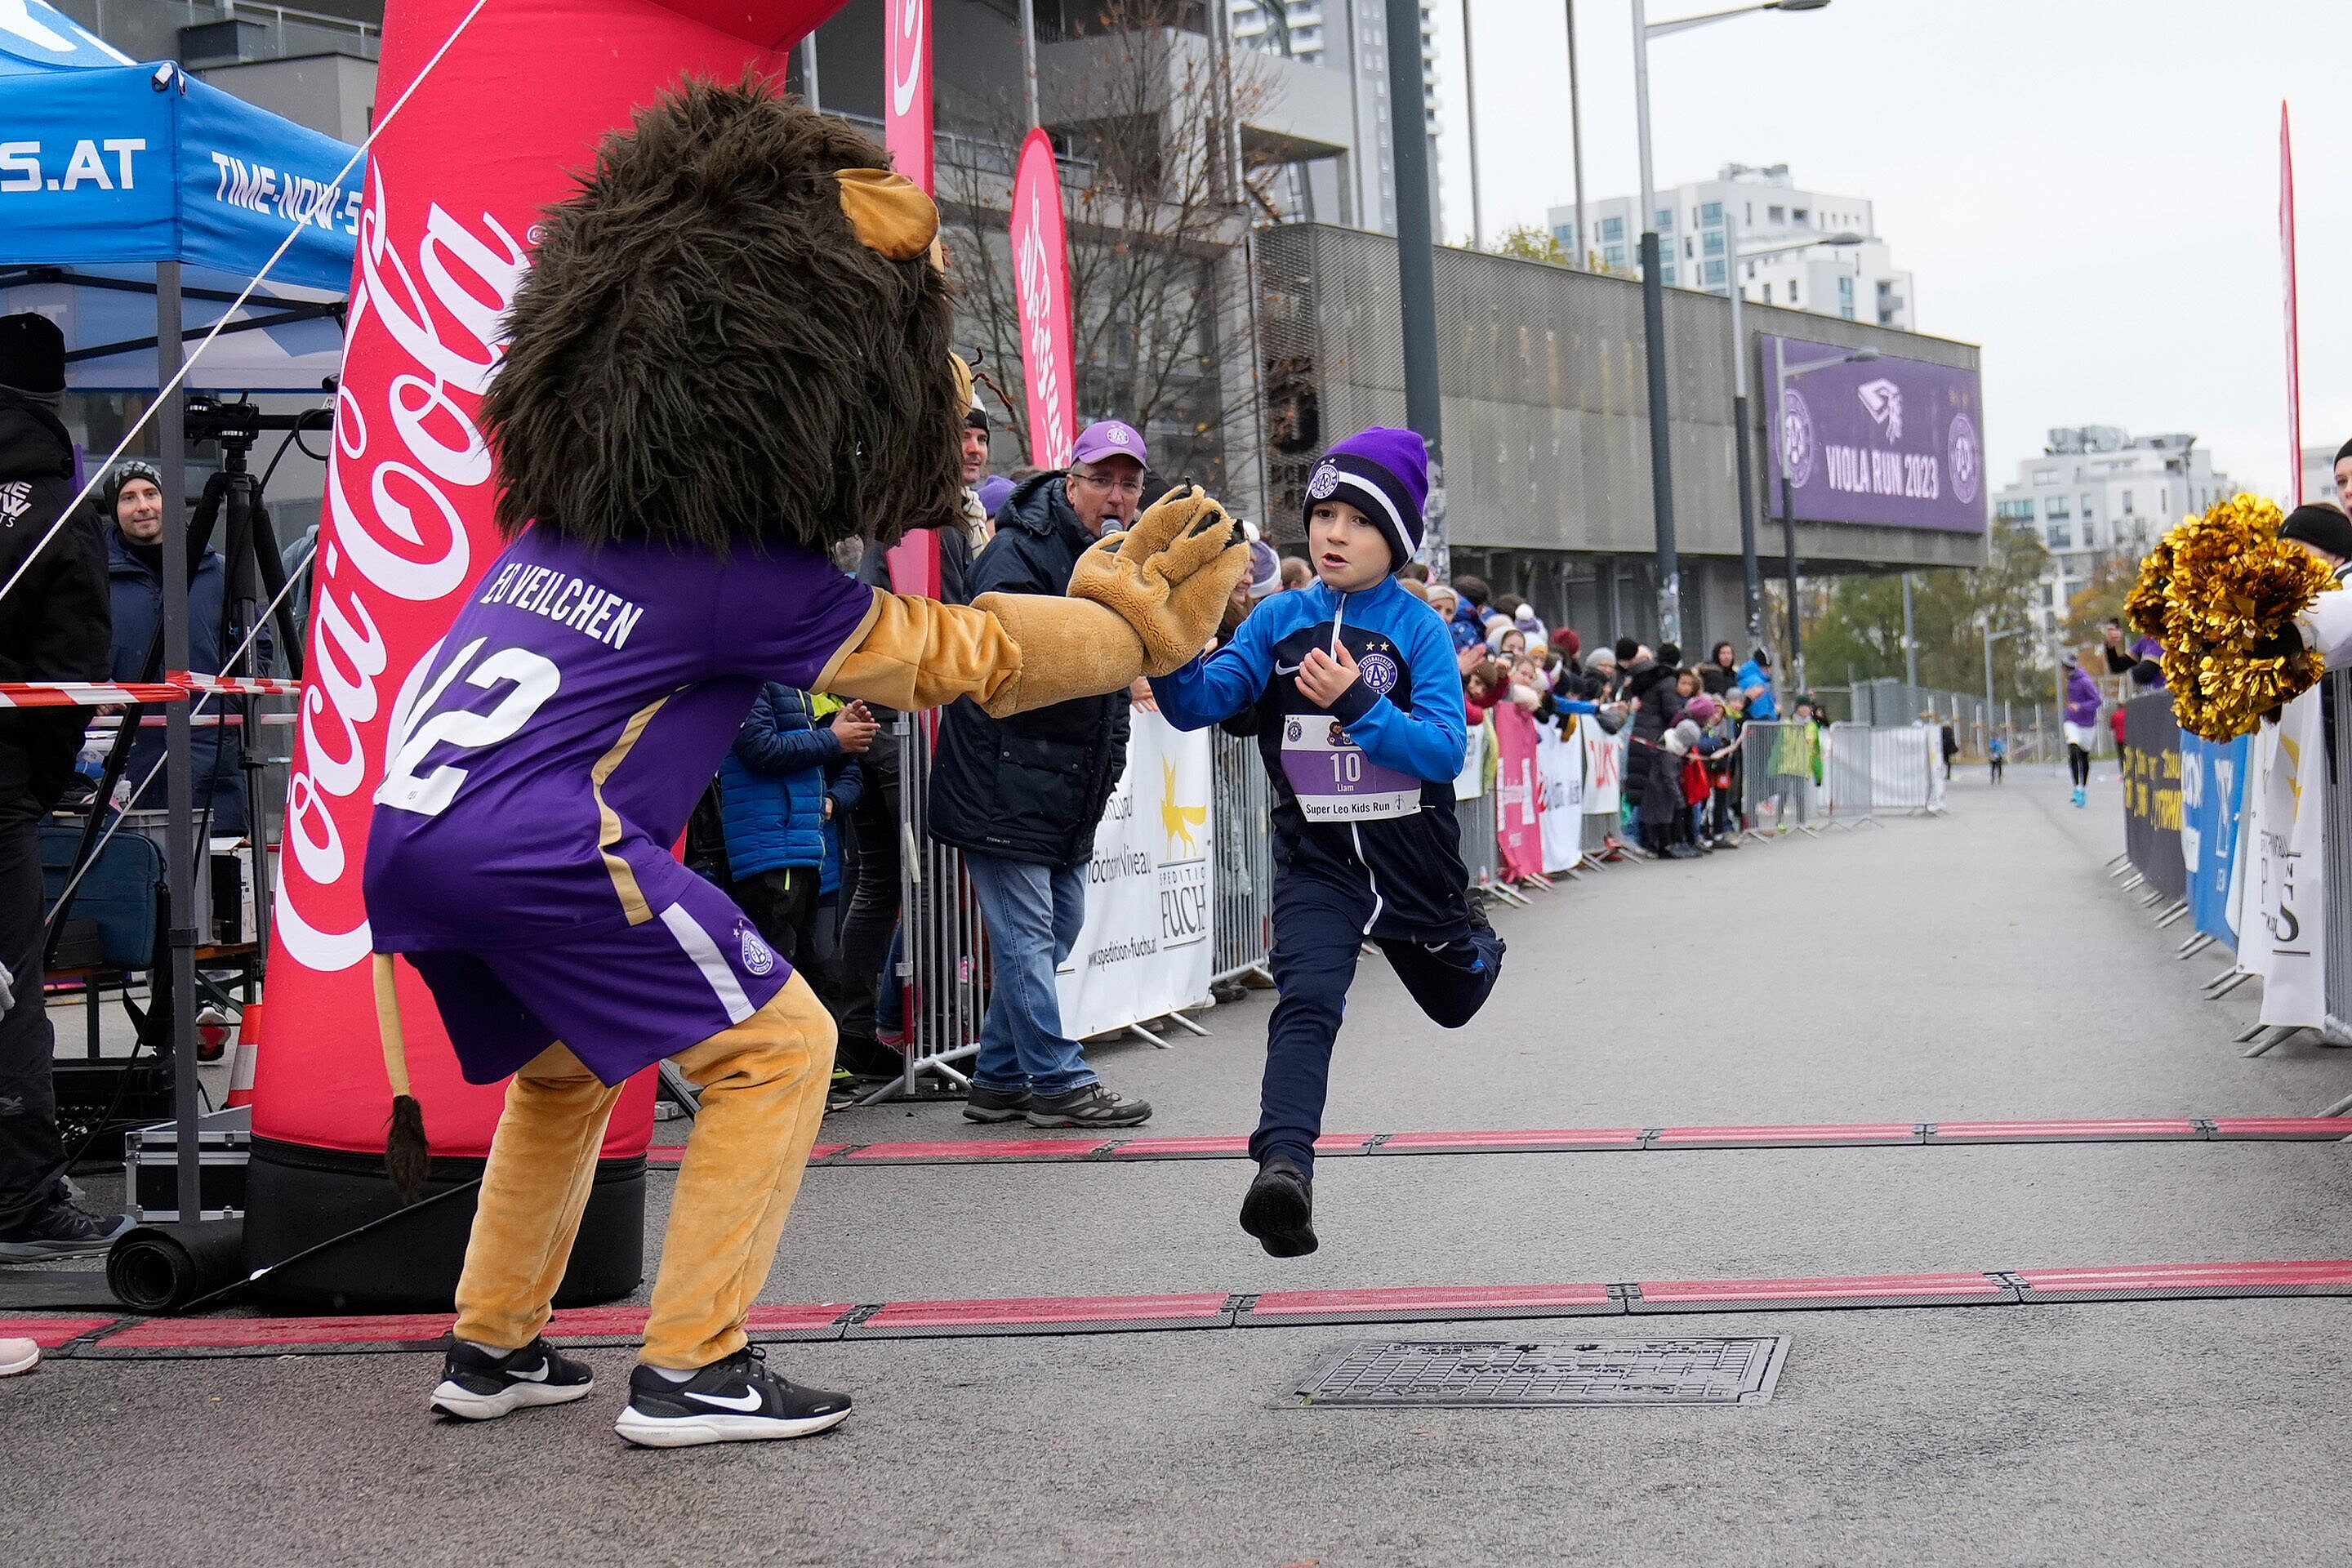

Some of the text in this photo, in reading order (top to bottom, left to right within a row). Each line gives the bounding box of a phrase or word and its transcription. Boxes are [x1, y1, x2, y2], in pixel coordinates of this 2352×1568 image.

[1825, 444, 1870, 492] VIOLA
[1871, 449, 1904, 496] RUN
[1904, 453, 1940, 500] 2023
[274, 154, 535, 972] Coca-Cola
[506, 564, 644, 650] VEILCHEN
[373, 636, 561, 816] 12
[1330, 752, 1362, 782] 10
[1337, 783, 1355, 792] Liam
[1306, 801, 1391, 816] Super Leo Kids Run
